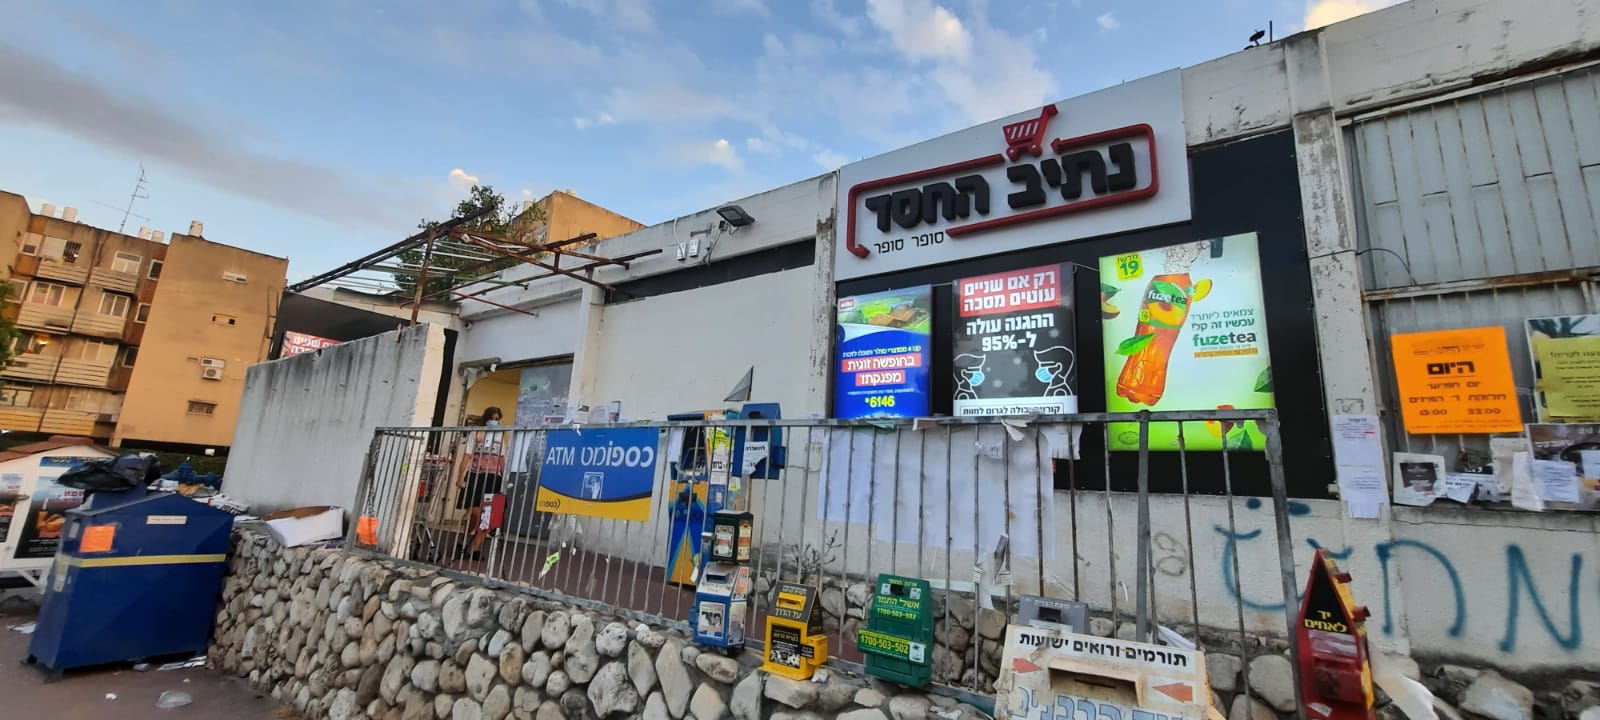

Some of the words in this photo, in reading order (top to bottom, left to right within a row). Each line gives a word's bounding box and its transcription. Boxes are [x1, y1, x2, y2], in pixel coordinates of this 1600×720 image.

[1007, 142, 1136, 210] נתיב
[866, 174, 990, 233] החסד
[874, 239, 904, 254] סופר
[911, 231, 944, 249] סופר
[1120, 260, 1139, 276] 19
[964, 279, 1004, 296] שניים
[1007, 275, 1030, 291] אם
[1033, 271, 1056, 289] רק
[964, 294, 1005, 312] מסכה
[1010, 288, 1056, 306] עוטים
[1223, 308, 1254, 318] צמאים
[966, 318, 1002, 335] עולה
[1005, 313, 1055, 331] ההגנה
[1211, 321, 1223, 329] זה
[1225, 318, 1255, 328] עכשיו
[1192, 332, 1257, 347] fuzetea
[847, 359, 872, 371] זוגית
[873, 356, 915, 368] בחופשה
[1427, 361, 1475, 375] היום
[546, 446, 575, 466] ATM
[1316, 610, 1331, 619] יד
[1304, 619, 1347, 632] לאחים
[861, 635, 909, 654] 1700-503-502
[1073, 640, 1120, 658] ורואים
[1126, 647, 1187, 667] תורמים
